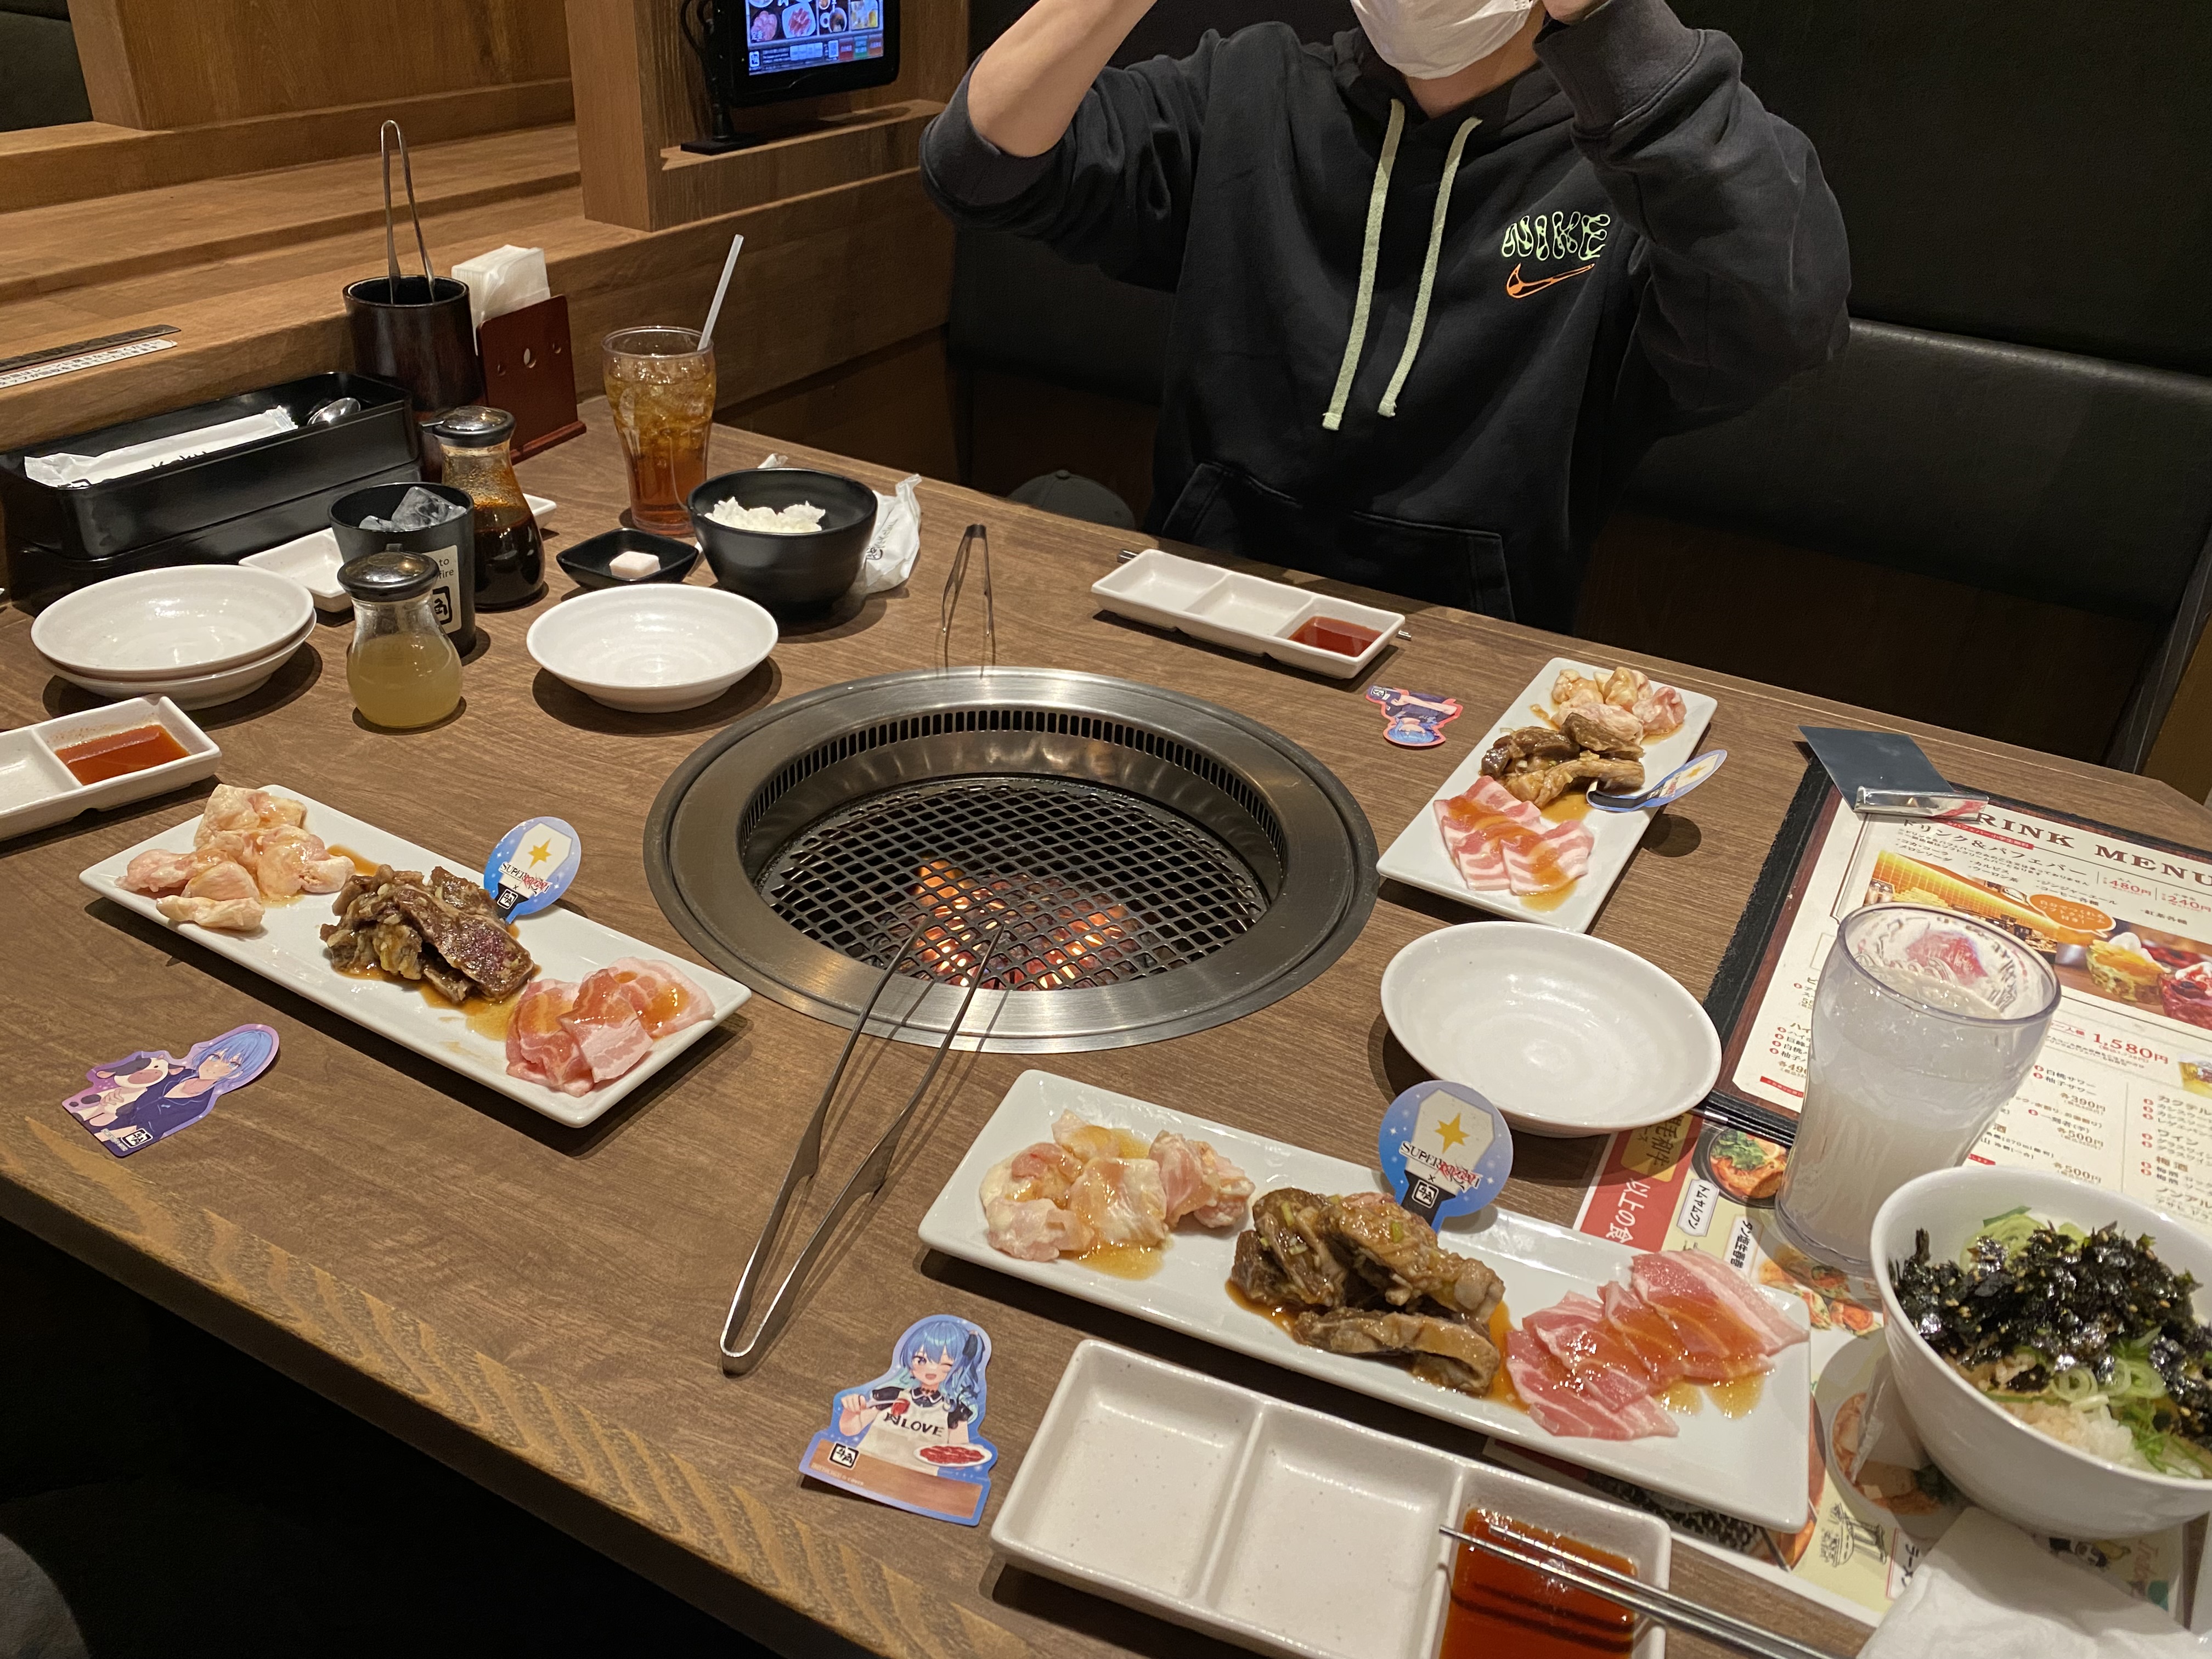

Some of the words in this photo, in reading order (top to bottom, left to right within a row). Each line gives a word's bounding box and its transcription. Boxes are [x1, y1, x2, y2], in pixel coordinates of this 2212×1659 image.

[1501, 211, 1611, 262] NIKE
[439, 569, 454, 579] fire
[1975, 812, 2075, 849] RINK
[2095, 844, 2212, 887] MENU
[2109, 880, 2152, 896] 480円
[2168, 895, 2212, 913] 240円
[2093, 1033, 2169, 1064] 1,580円
[2045, 1076, 2097, 1096] 柚子サワー
[2046, 1069, 2096, 1088] 白桃サワー
[1637, 1125, 1652, 1142] ース
[2157, 1128, 2199, 1146] ワイン
[1688, 1184, 1711, 1229] トムヤムクン
